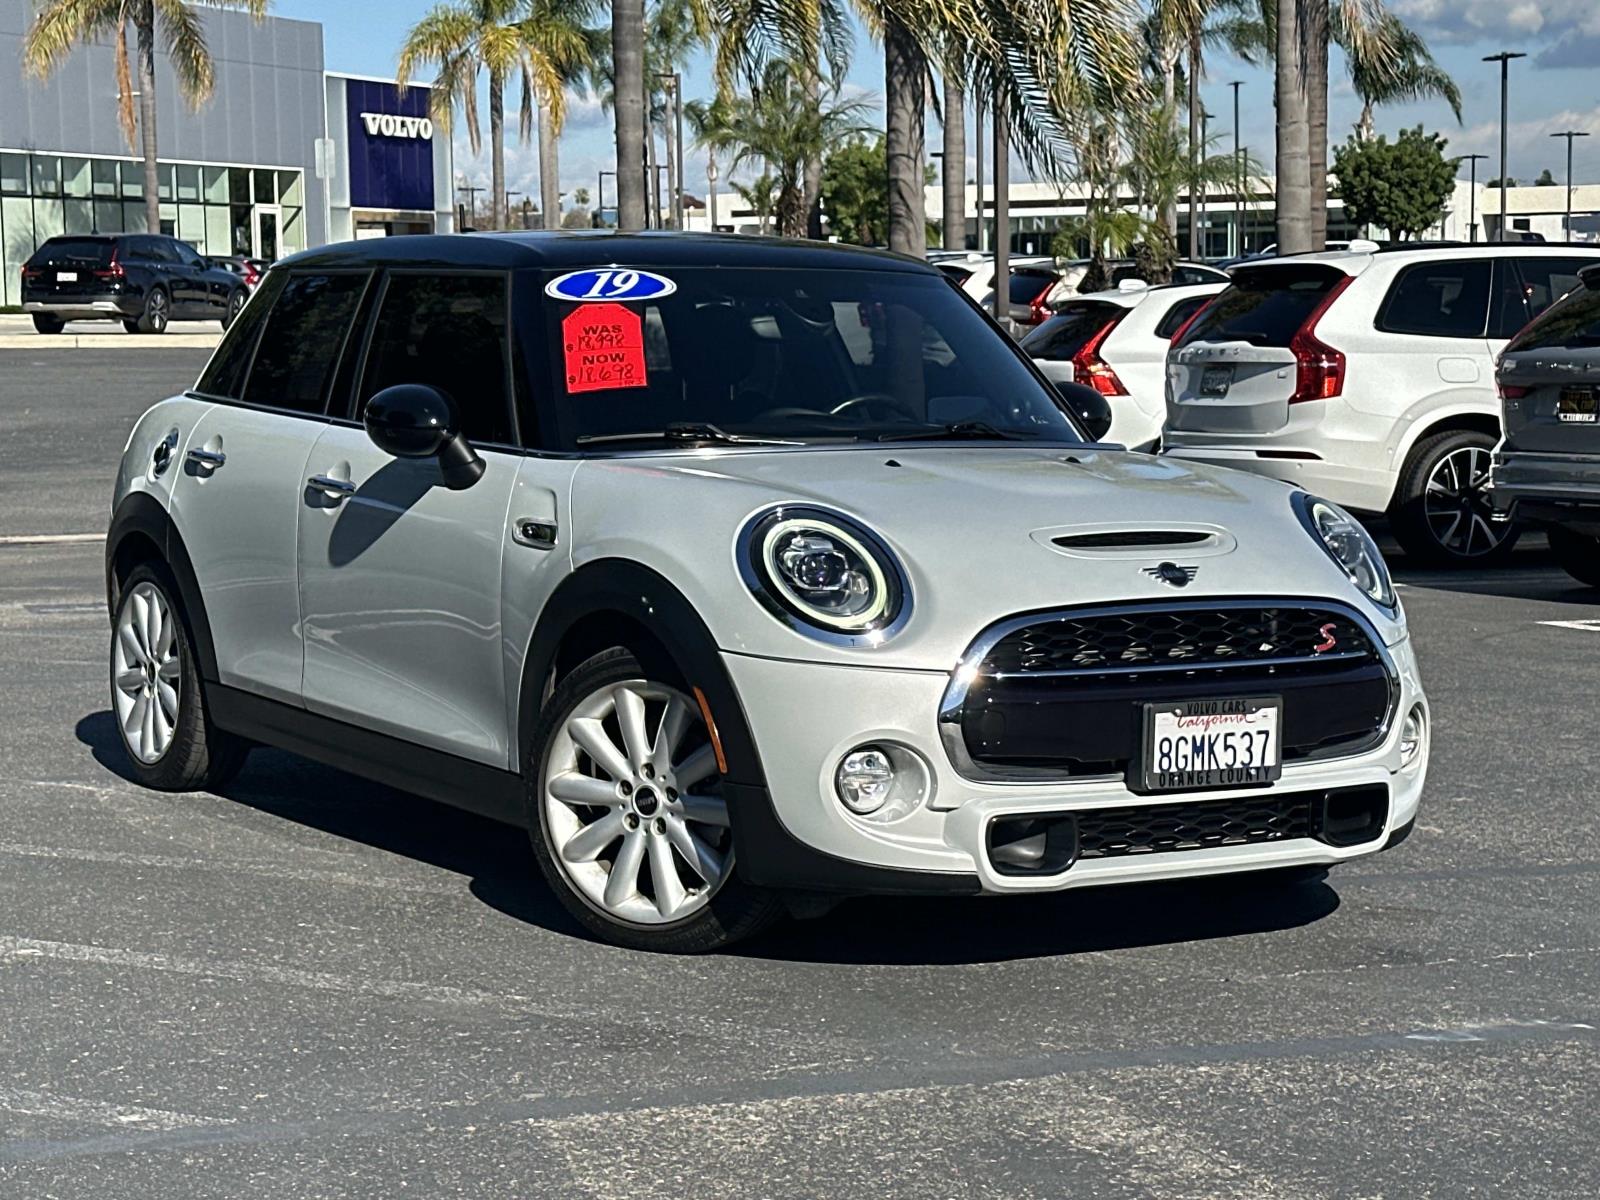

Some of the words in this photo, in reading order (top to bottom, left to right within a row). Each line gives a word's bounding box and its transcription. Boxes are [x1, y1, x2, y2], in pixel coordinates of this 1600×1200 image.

[360, 112, 433, 140] VOLVO
[582, 272, 640, 298] 19
[583, 325, 623, 335] WAS
[582, 353, 625, 365] NOW
[1313, 623, 1337, 652] S
[1187, 702, 1217, 715] VOLVO
[1222, 700, 1247, 714] CARS
[1177, 713, 1256, 731] California
[1158, 730, 1270, 772] 8GMK537
[1159, 770, 1211, 788] ORANGE
[1219, 767, 1271, 784] COUNTY
